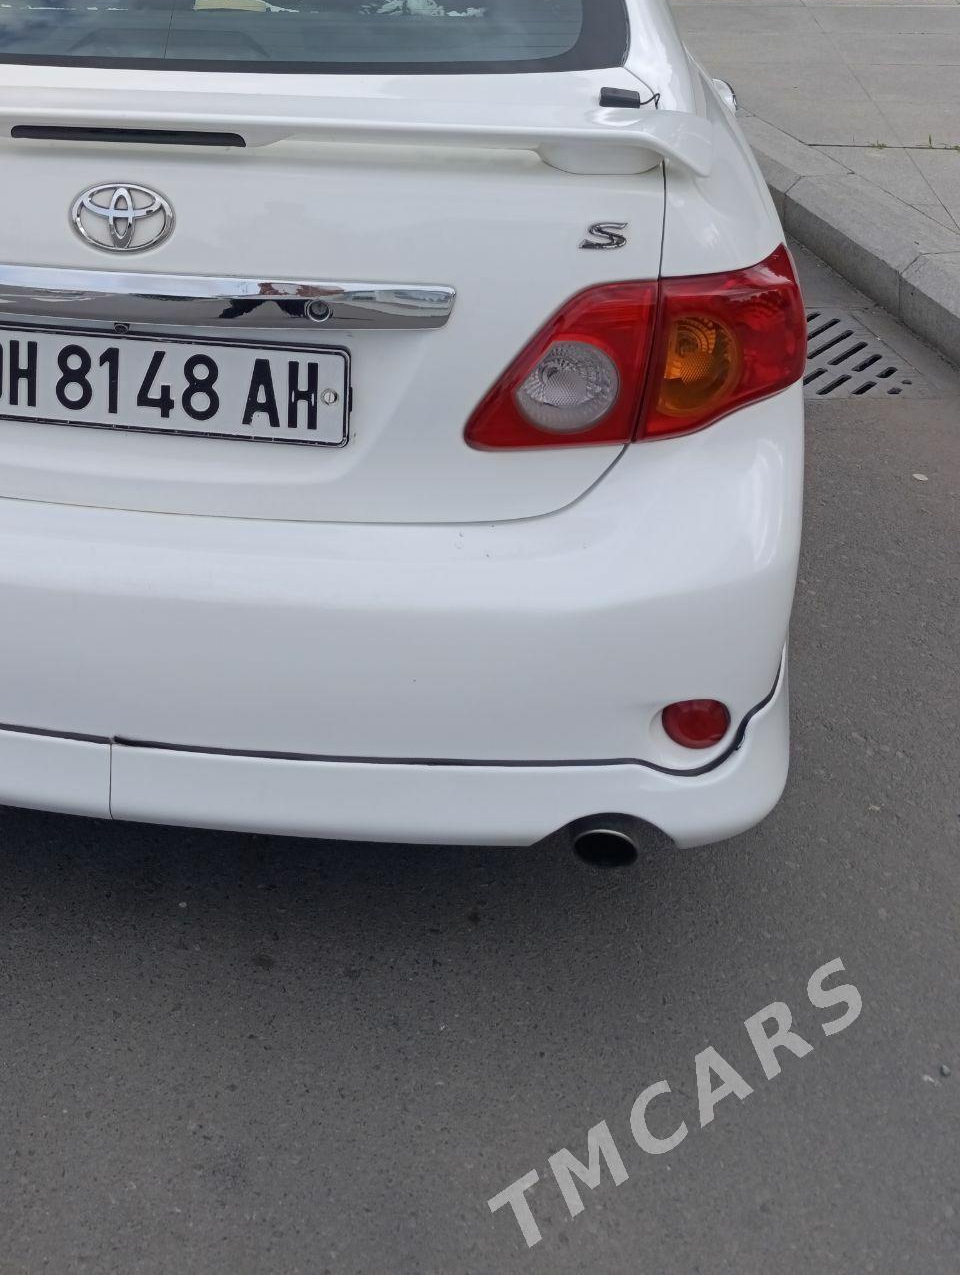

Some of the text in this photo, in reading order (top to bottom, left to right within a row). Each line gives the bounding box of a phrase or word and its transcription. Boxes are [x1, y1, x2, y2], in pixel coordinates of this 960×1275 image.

[578, 222, 628, 250] S
[55, 343, 220, 421] 8148
[241, 357, 319, 430] AH
